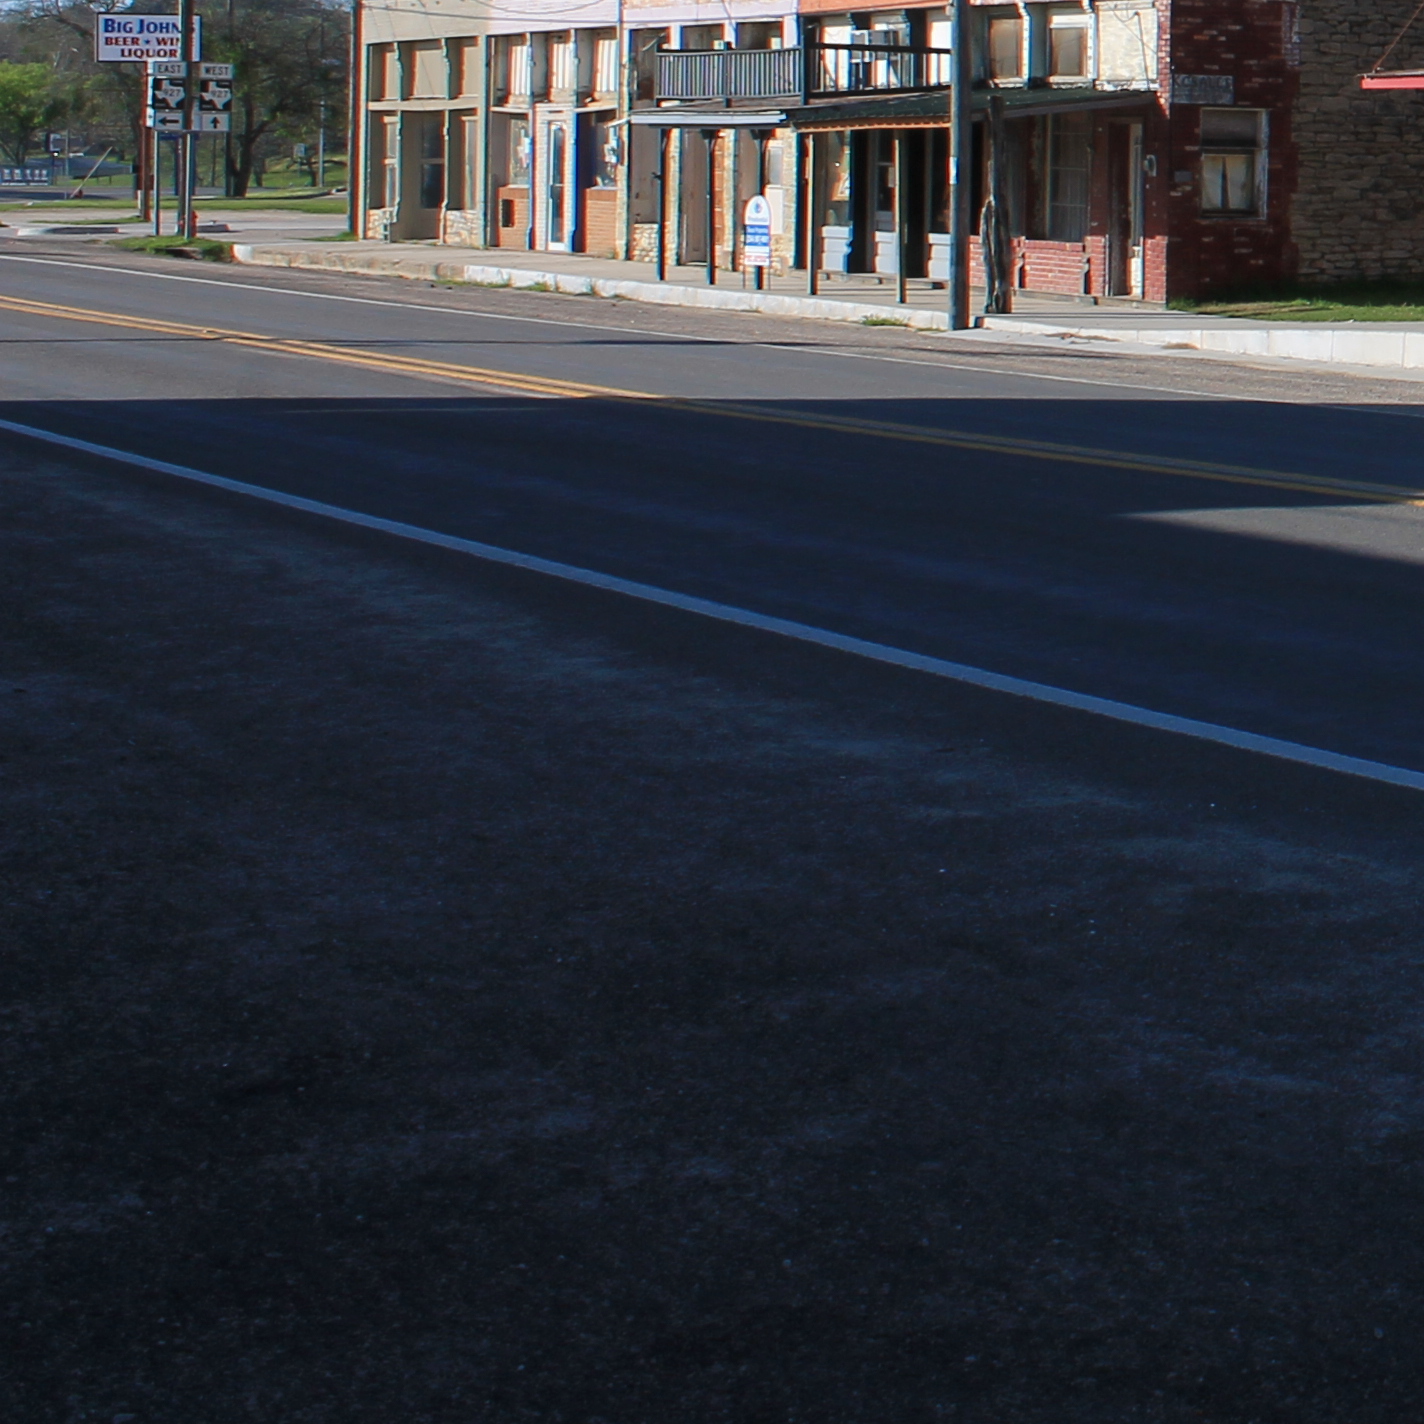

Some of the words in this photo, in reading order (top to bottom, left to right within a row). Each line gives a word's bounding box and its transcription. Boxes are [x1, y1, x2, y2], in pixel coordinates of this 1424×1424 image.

[138, 18, 195, 34] JOHN
[105, 37, 140, 46] BEER
[121, 48, 179, 59] LIQUOR
[157, 64, 182, 74] EAST
[204, 66, 229, 75] WEST
[163, 88, 182, 97] 927
